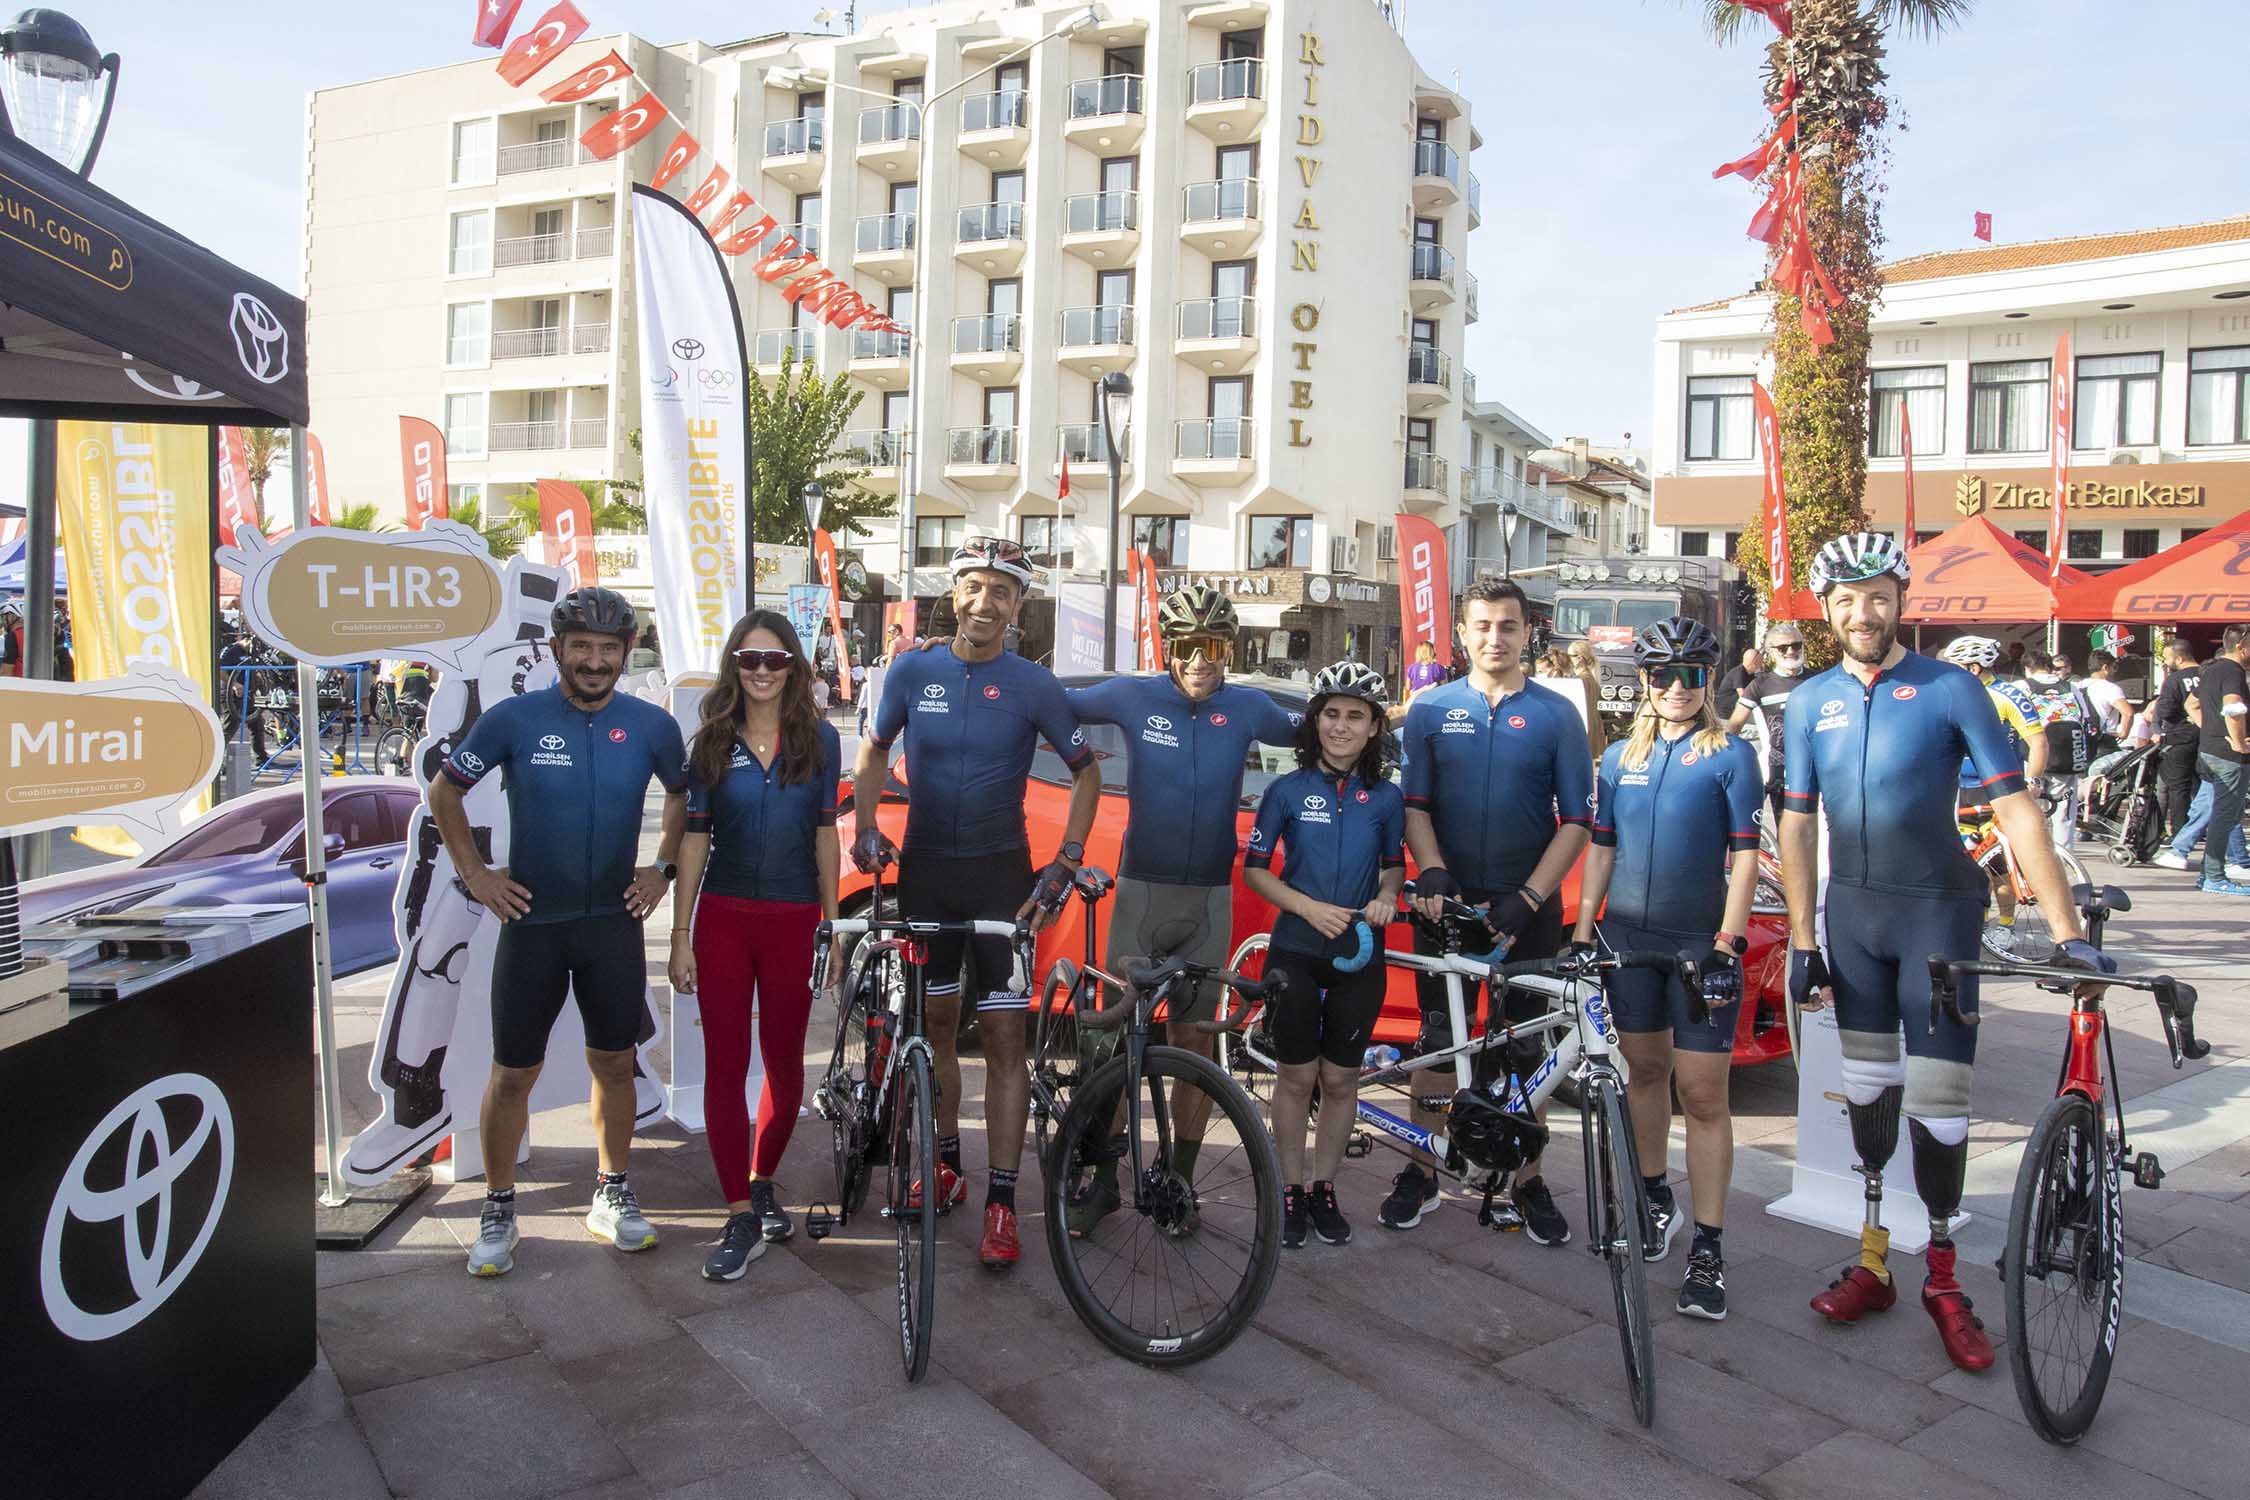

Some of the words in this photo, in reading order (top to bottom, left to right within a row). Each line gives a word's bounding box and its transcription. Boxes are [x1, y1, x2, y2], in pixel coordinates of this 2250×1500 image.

[1291, 31, 1325, 271] RIDVAN
[1288, 302, 1321, 448] OTEL
[2081, 480, 2201, 507] Bankası
[307, 564, 463, 608] T-HR3
[1996, 681, 2033, 713] SAXO
[10, 716, 144, 768] Mirai
[988, 990, 1022, 1000] Santini
[1362, 1109, 1428, 1146] GEOTECH
[2104, 1150, 2125, 1358] BONTRAGE
